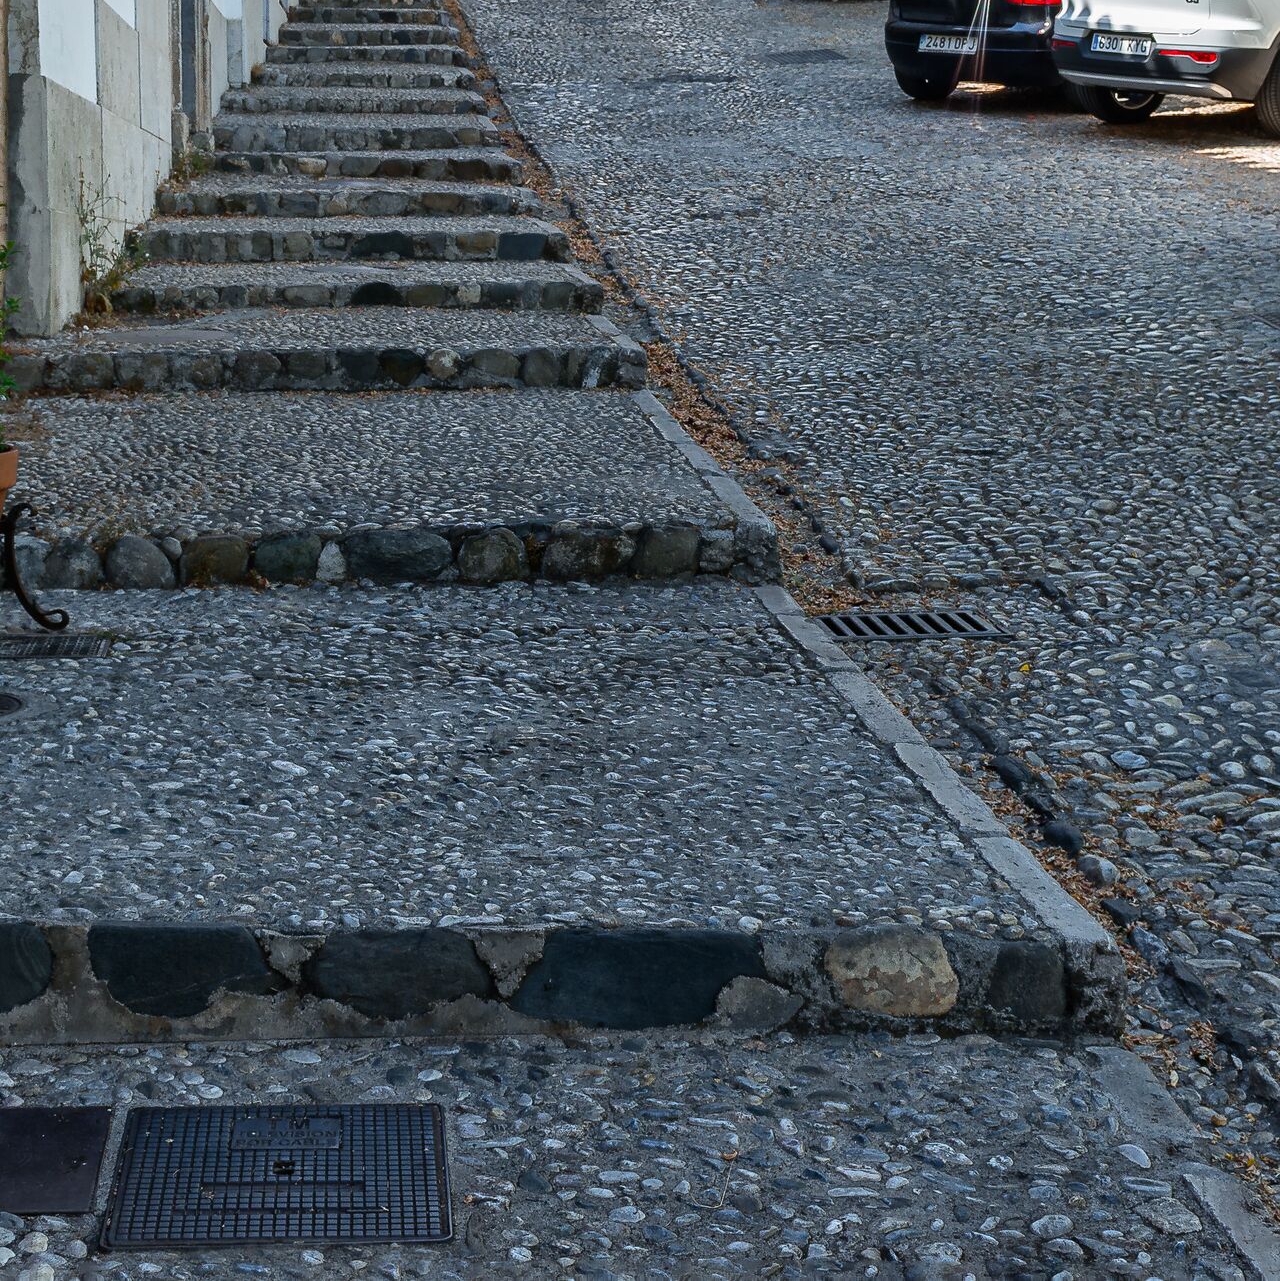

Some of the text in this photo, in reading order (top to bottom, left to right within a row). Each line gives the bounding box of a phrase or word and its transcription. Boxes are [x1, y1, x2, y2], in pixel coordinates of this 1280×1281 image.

[925, 36, 951, 49] 2481
[1098, 35, 1148, 53] 6301 KYG
